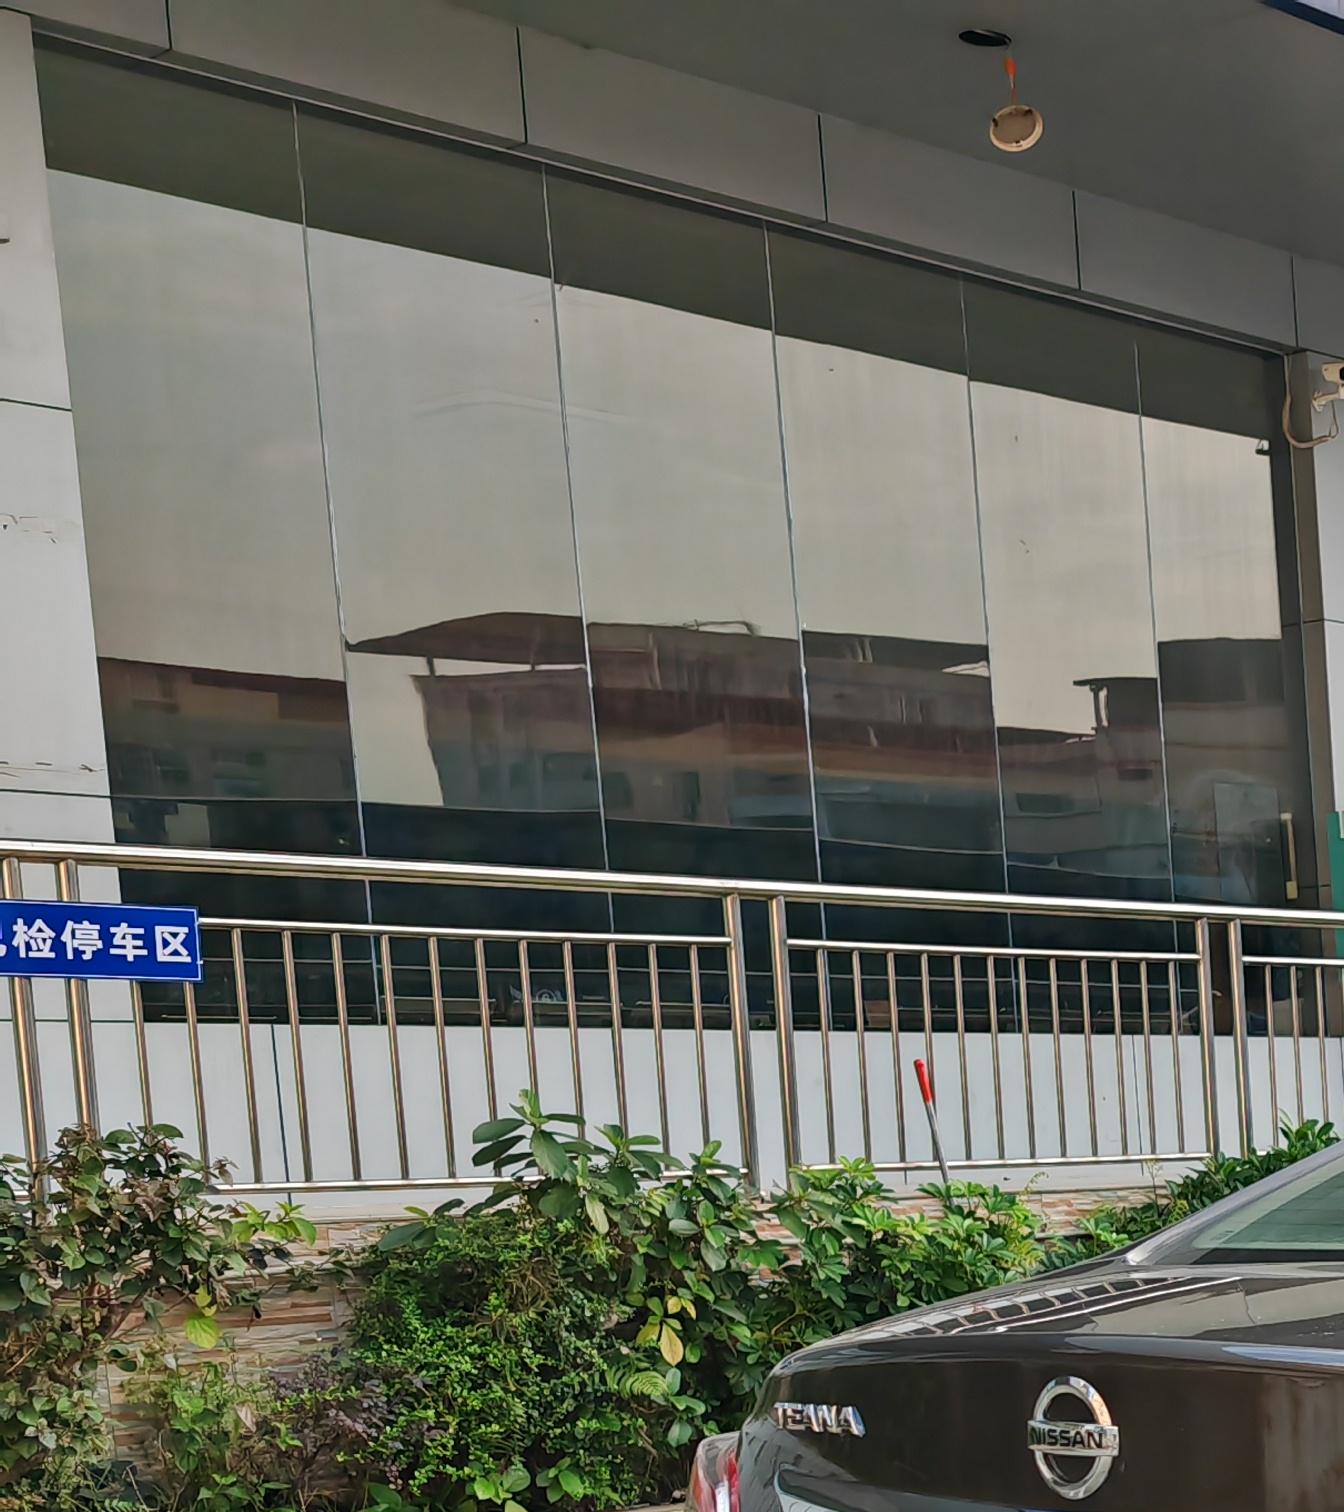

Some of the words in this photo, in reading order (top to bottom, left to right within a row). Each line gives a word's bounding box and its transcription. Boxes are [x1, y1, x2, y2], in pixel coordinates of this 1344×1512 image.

[0, 918, 192, 963] 检停车区
[772, 1401, 866, 1438] TEANA
[1029, 1425, 1105, 1450] NISSAN
